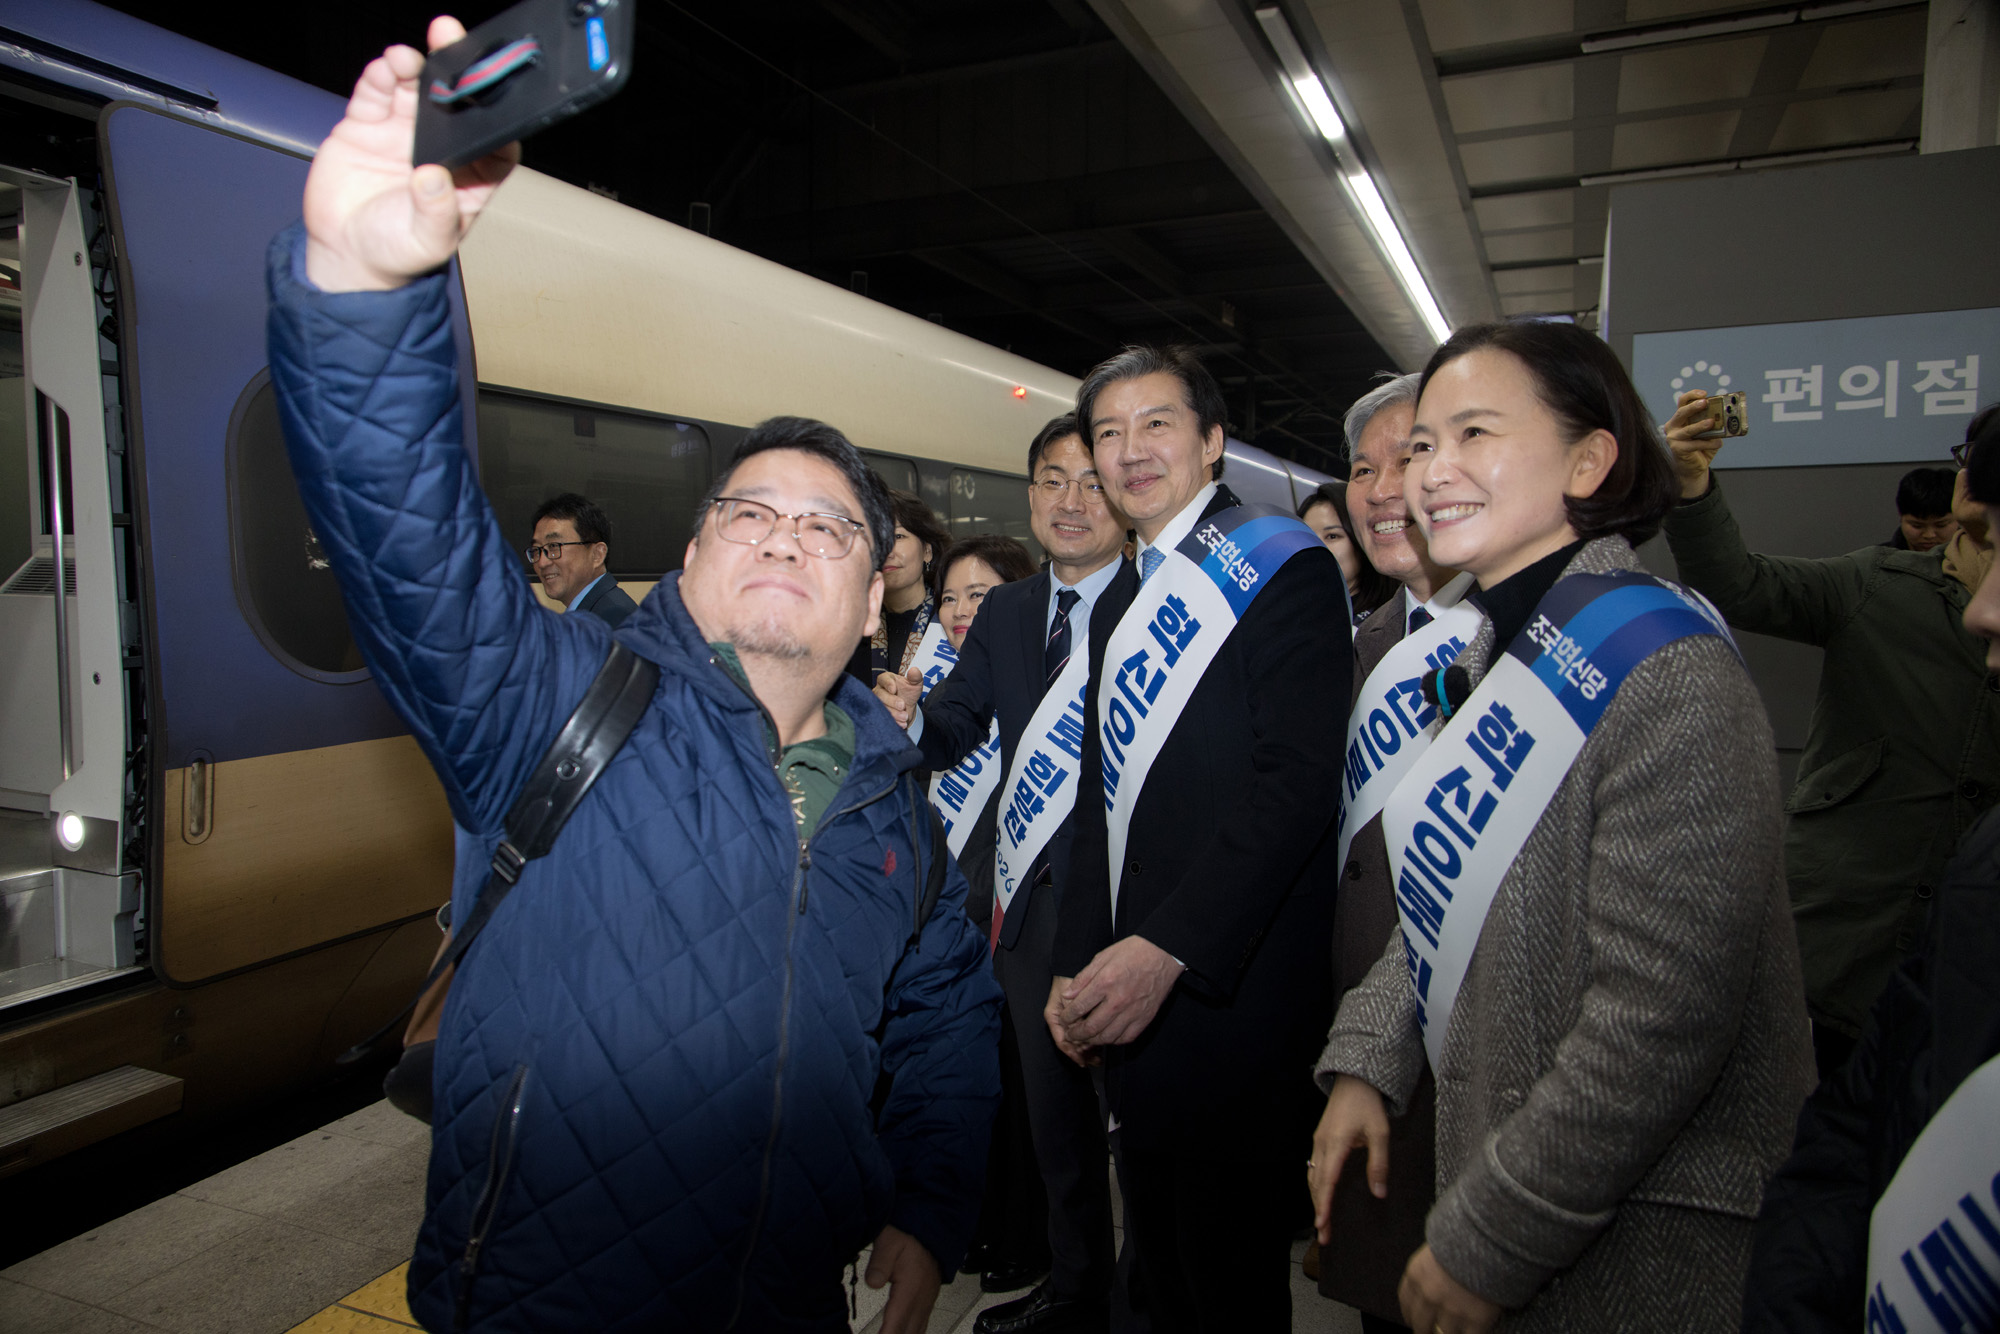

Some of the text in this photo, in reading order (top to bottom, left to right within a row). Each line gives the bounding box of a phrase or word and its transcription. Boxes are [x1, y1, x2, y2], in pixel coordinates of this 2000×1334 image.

[1762, 354, 1980, 423] 편의점
[1195, 523, 1260, 592] 조국혁신당
[1526, 613, 1608, 701] 조국혁신당
[1003, 749, 1069, 850] 희망찬
[1396, 700, 1537, 951] 혁신으로
